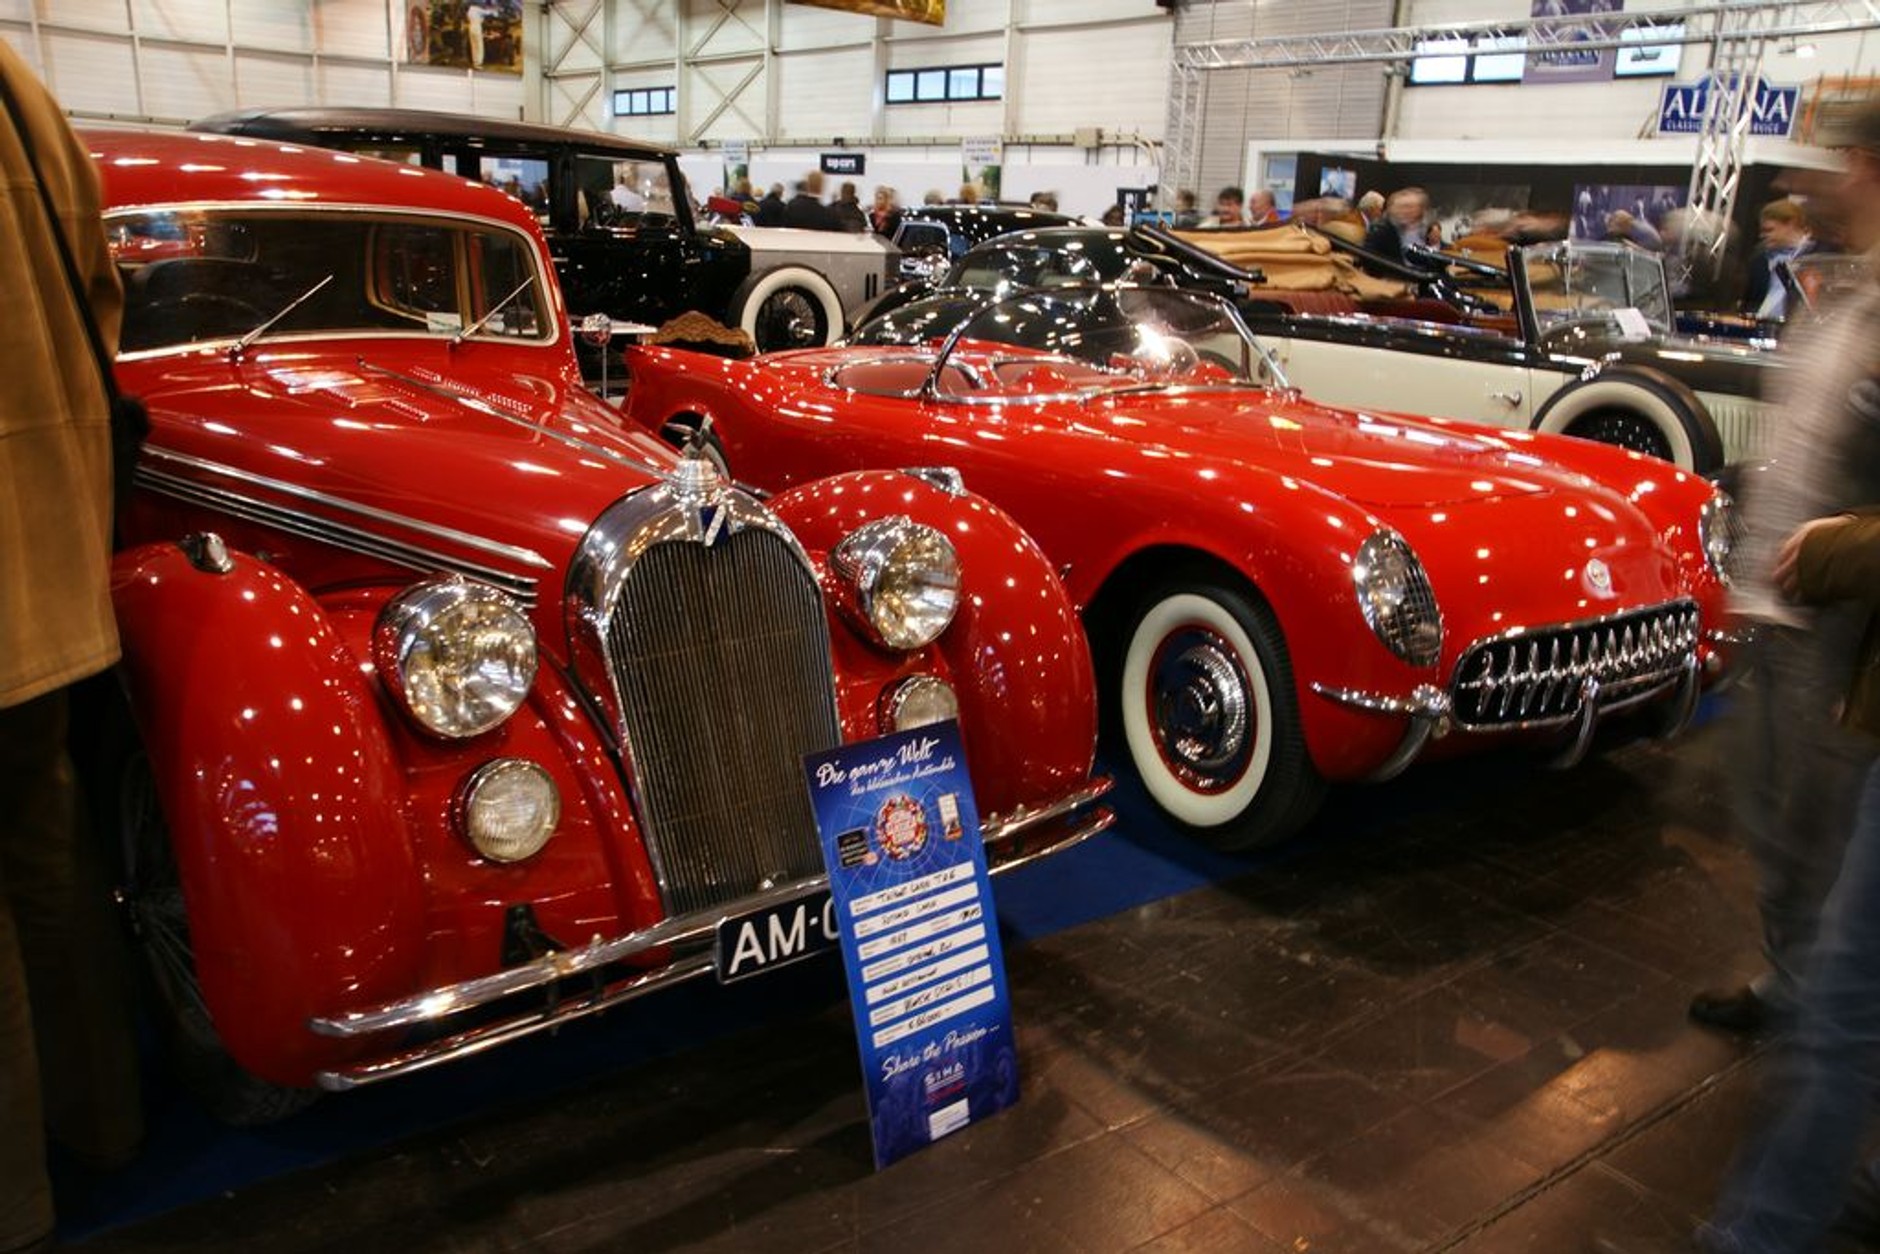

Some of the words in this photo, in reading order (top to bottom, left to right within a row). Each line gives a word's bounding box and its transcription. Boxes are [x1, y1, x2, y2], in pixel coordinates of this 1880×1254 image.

[816, 759, 847, 787] Die
[895, 737, 939, 764] Welt
[881, 1055, 921, 1082] Share
[923, 1039, 942, 1057] the
[942, 1022, 987, 1050] Passion
